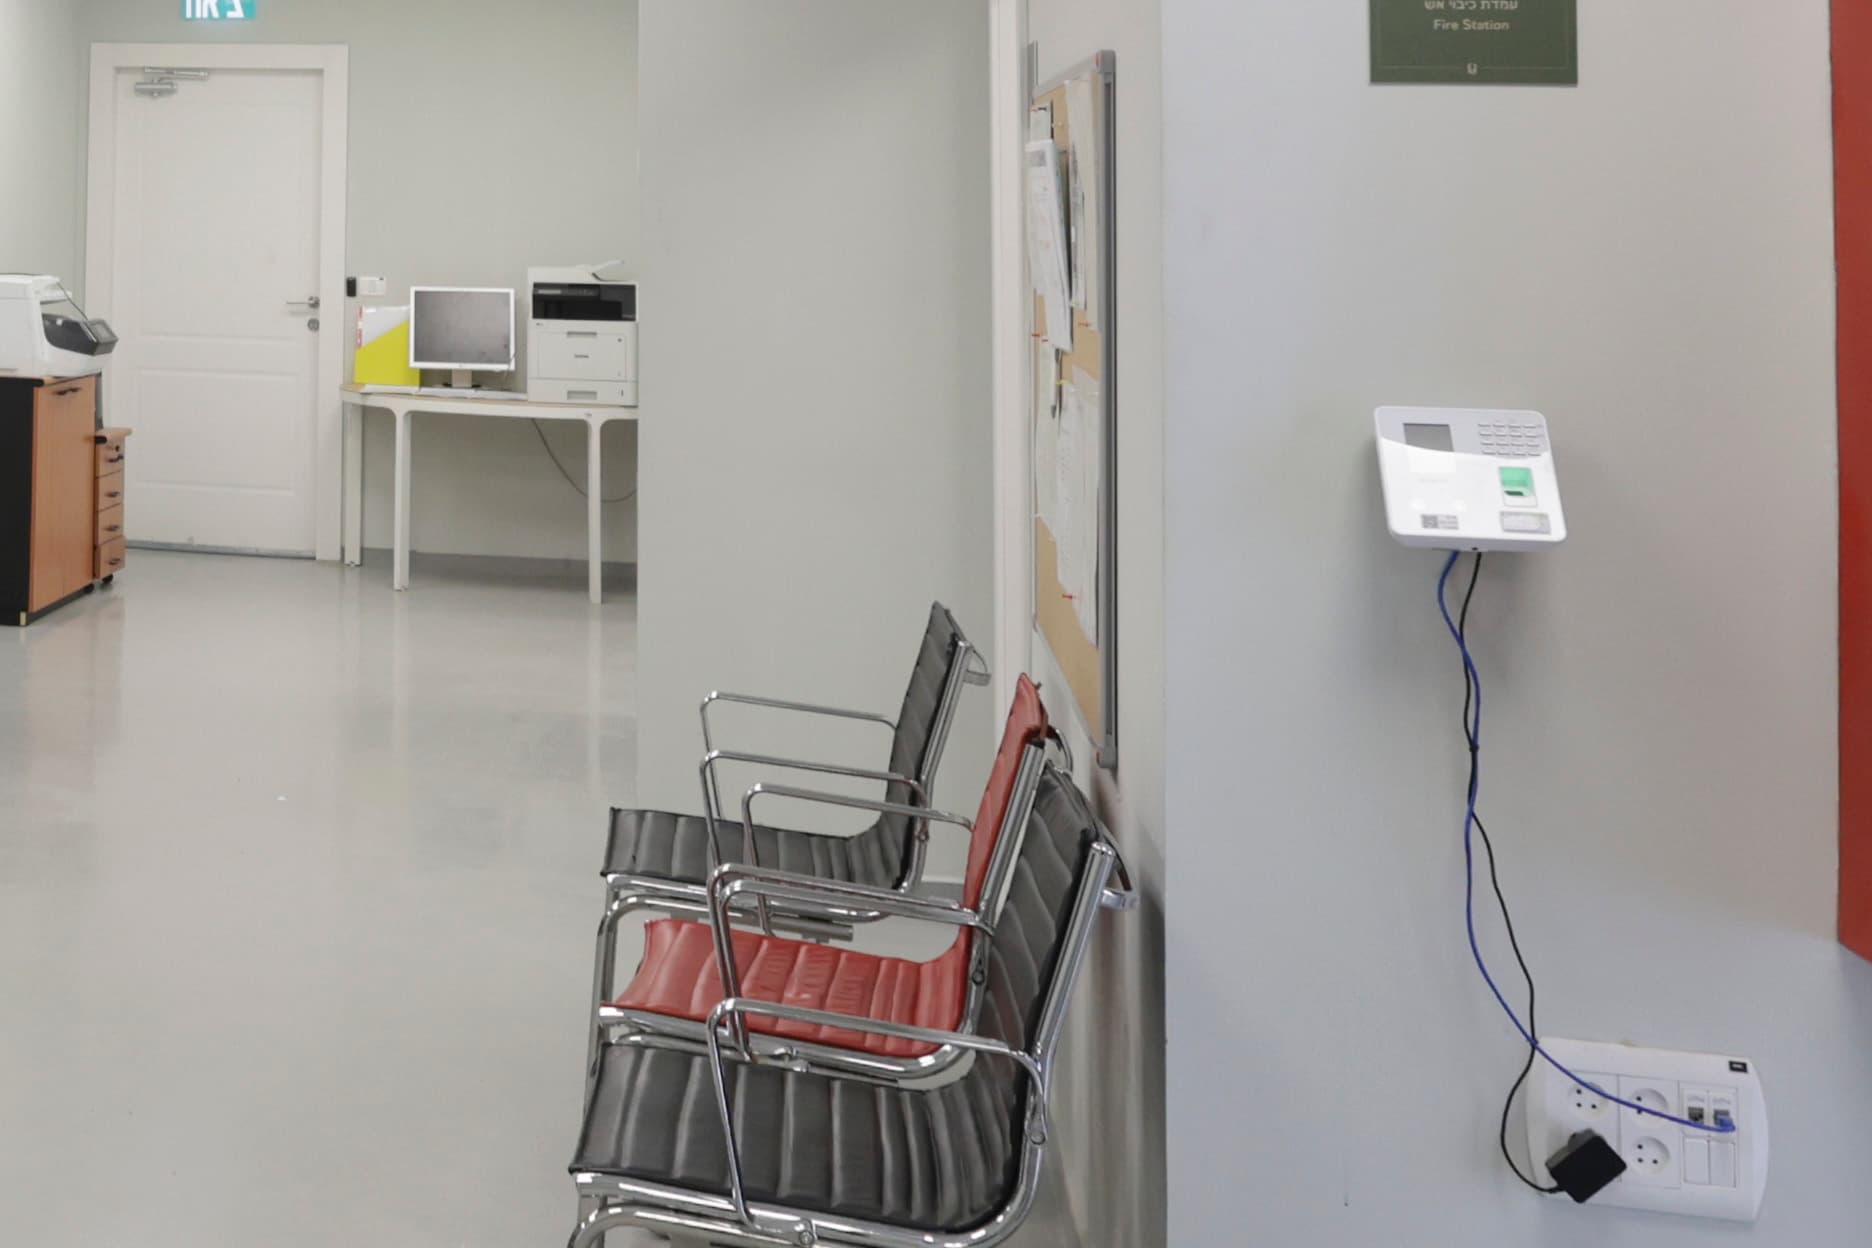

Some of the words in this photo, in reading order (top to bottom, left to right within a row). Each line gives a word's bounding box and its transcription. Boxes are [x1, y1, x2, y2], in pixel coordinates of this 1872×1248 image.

[1424, 0, 1445, 10] אש
[1449, 0, 1477, 10] כיבוי
[1480, 0, 1519, 10] עמדת
[1433, 19, 1459, 31] Fire
[1463, 18, 1510, 31] Station
